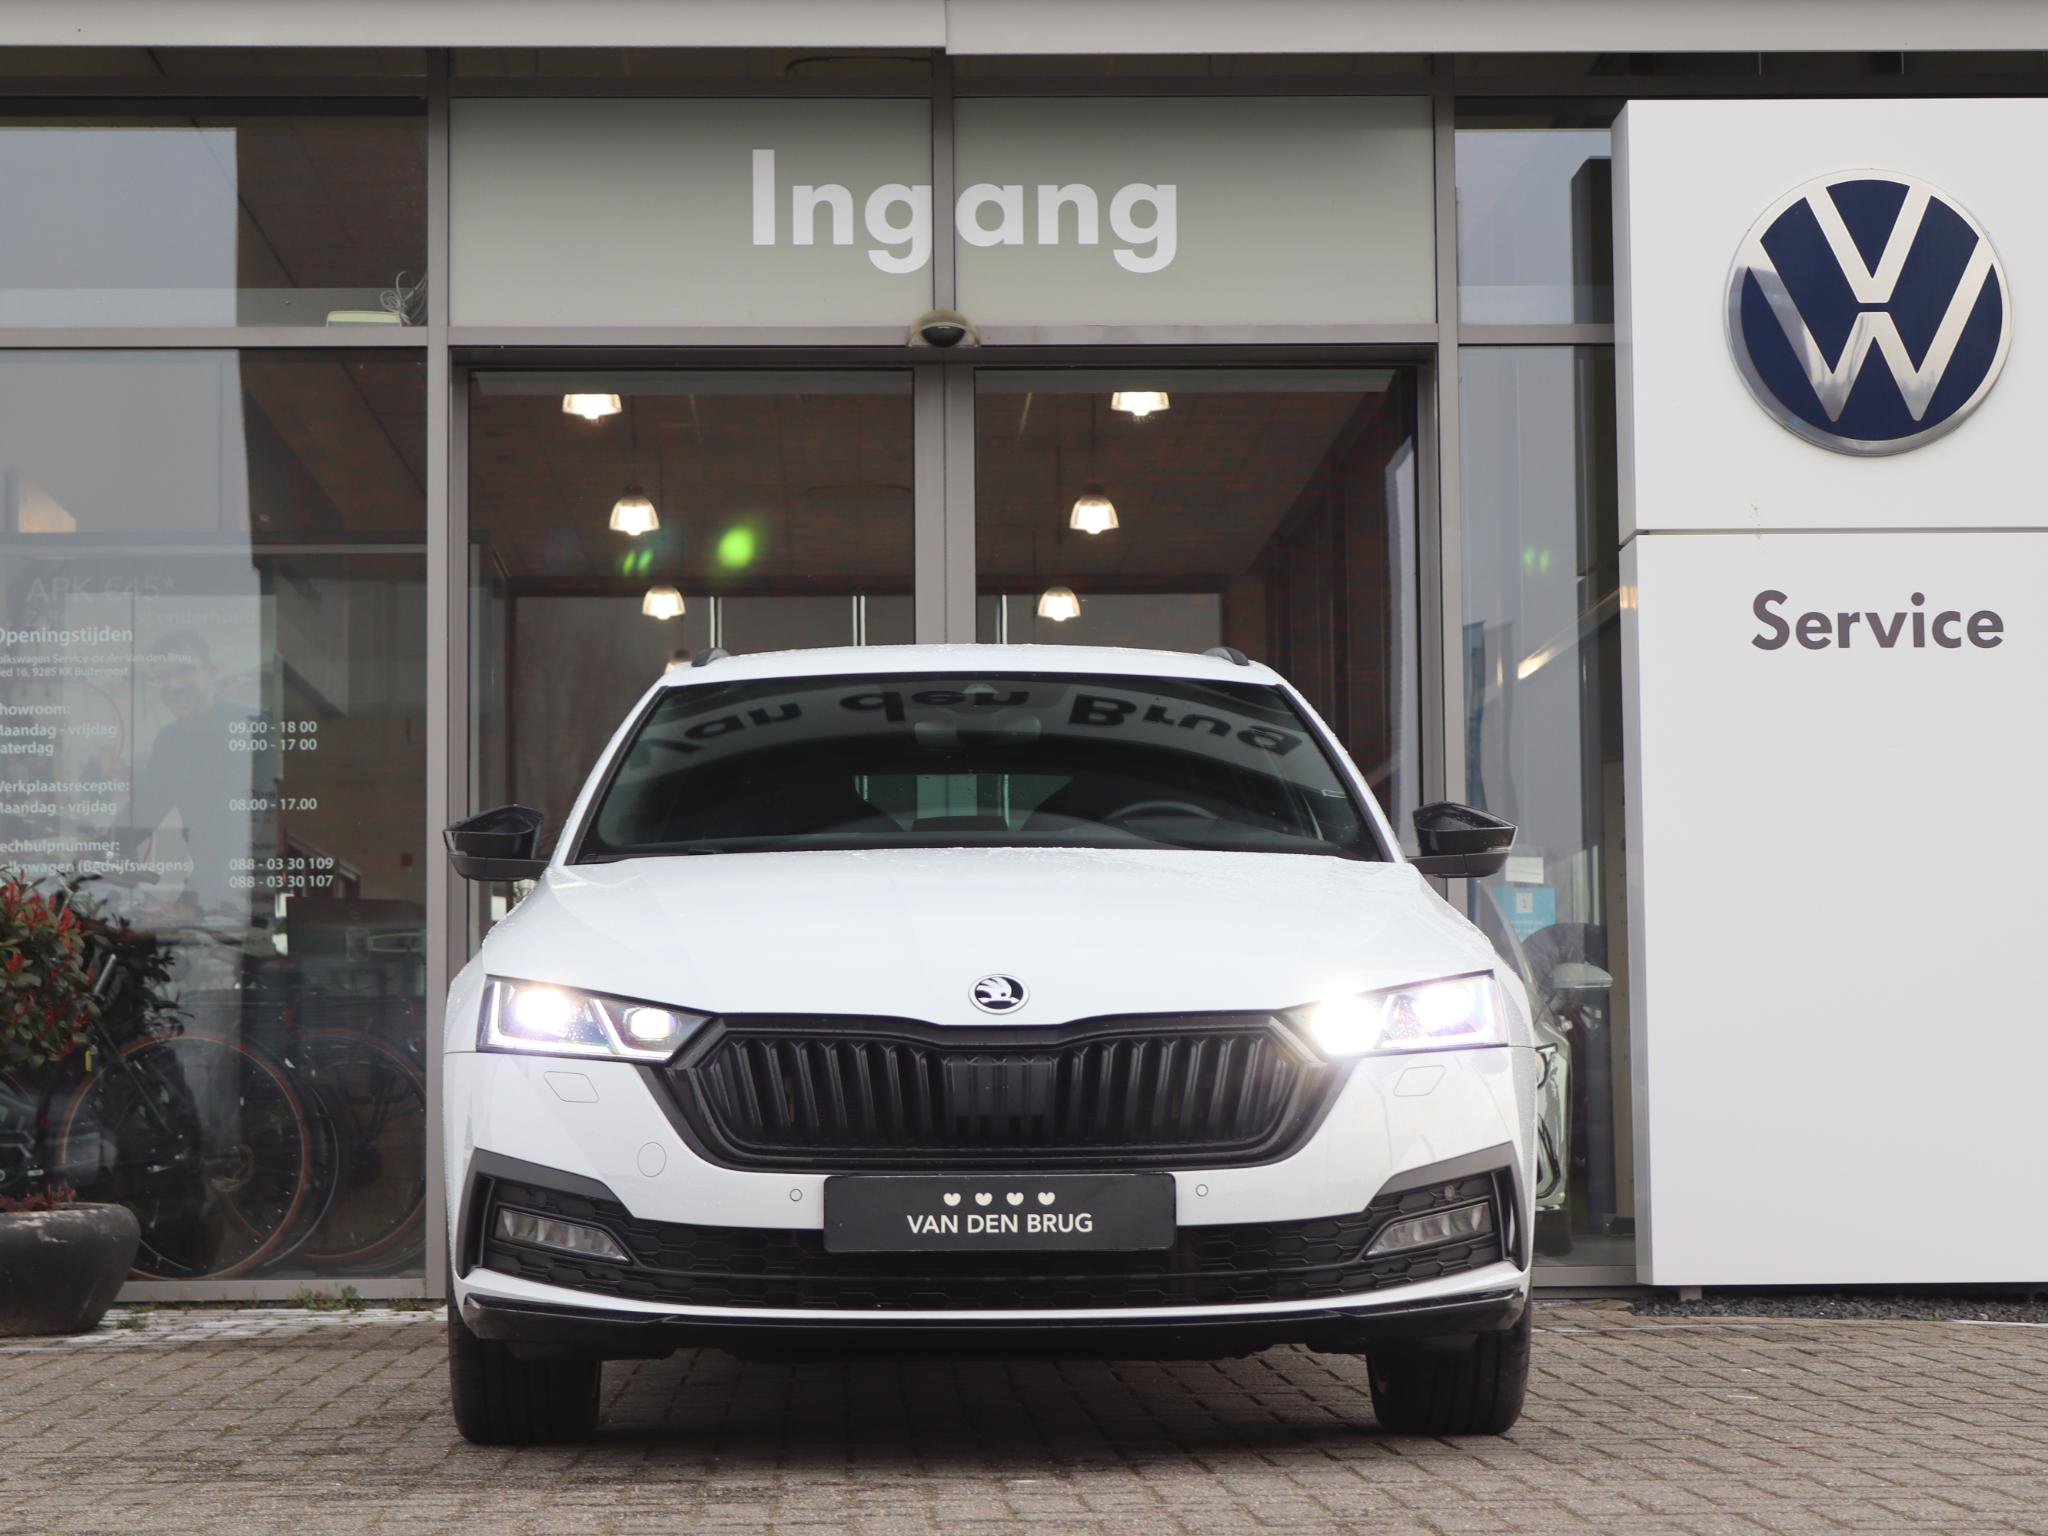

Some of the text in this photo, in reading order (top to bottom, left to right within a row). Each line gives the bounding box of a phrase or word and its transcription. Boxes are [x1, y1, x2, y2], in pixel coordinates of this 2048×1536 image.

[752, 149, 1178, 273] Ingang
[1751, 589, 2005, 651] Service
[0, 703, 71, 716] howroom:
[68, 722, 117, 738] vrijdag
[229, 721, 267, 733] 09.00
[229, 739, 267, 751] 09.00
[68, 800, 118, 815] vrijdag
[229, 798, 267, 811] 08.00
[280, 798, 317, 810] 17.00
[79, 859, 194, 875] (Bedrijfswagens)
[229, 858, 255, 870] 088
[267, 858, 283, 869] 03
[288, 858, 304, 869] 30
[309, 857, 334, 869] 109
[229, 875, 255, 888] 088
[267, 875, 283, 887] 03
[288, 875, 304, 887] 30
[309, 875, 333, 887] 107
[907, 1213, 1093, 1234] VAN DEN BRUG
